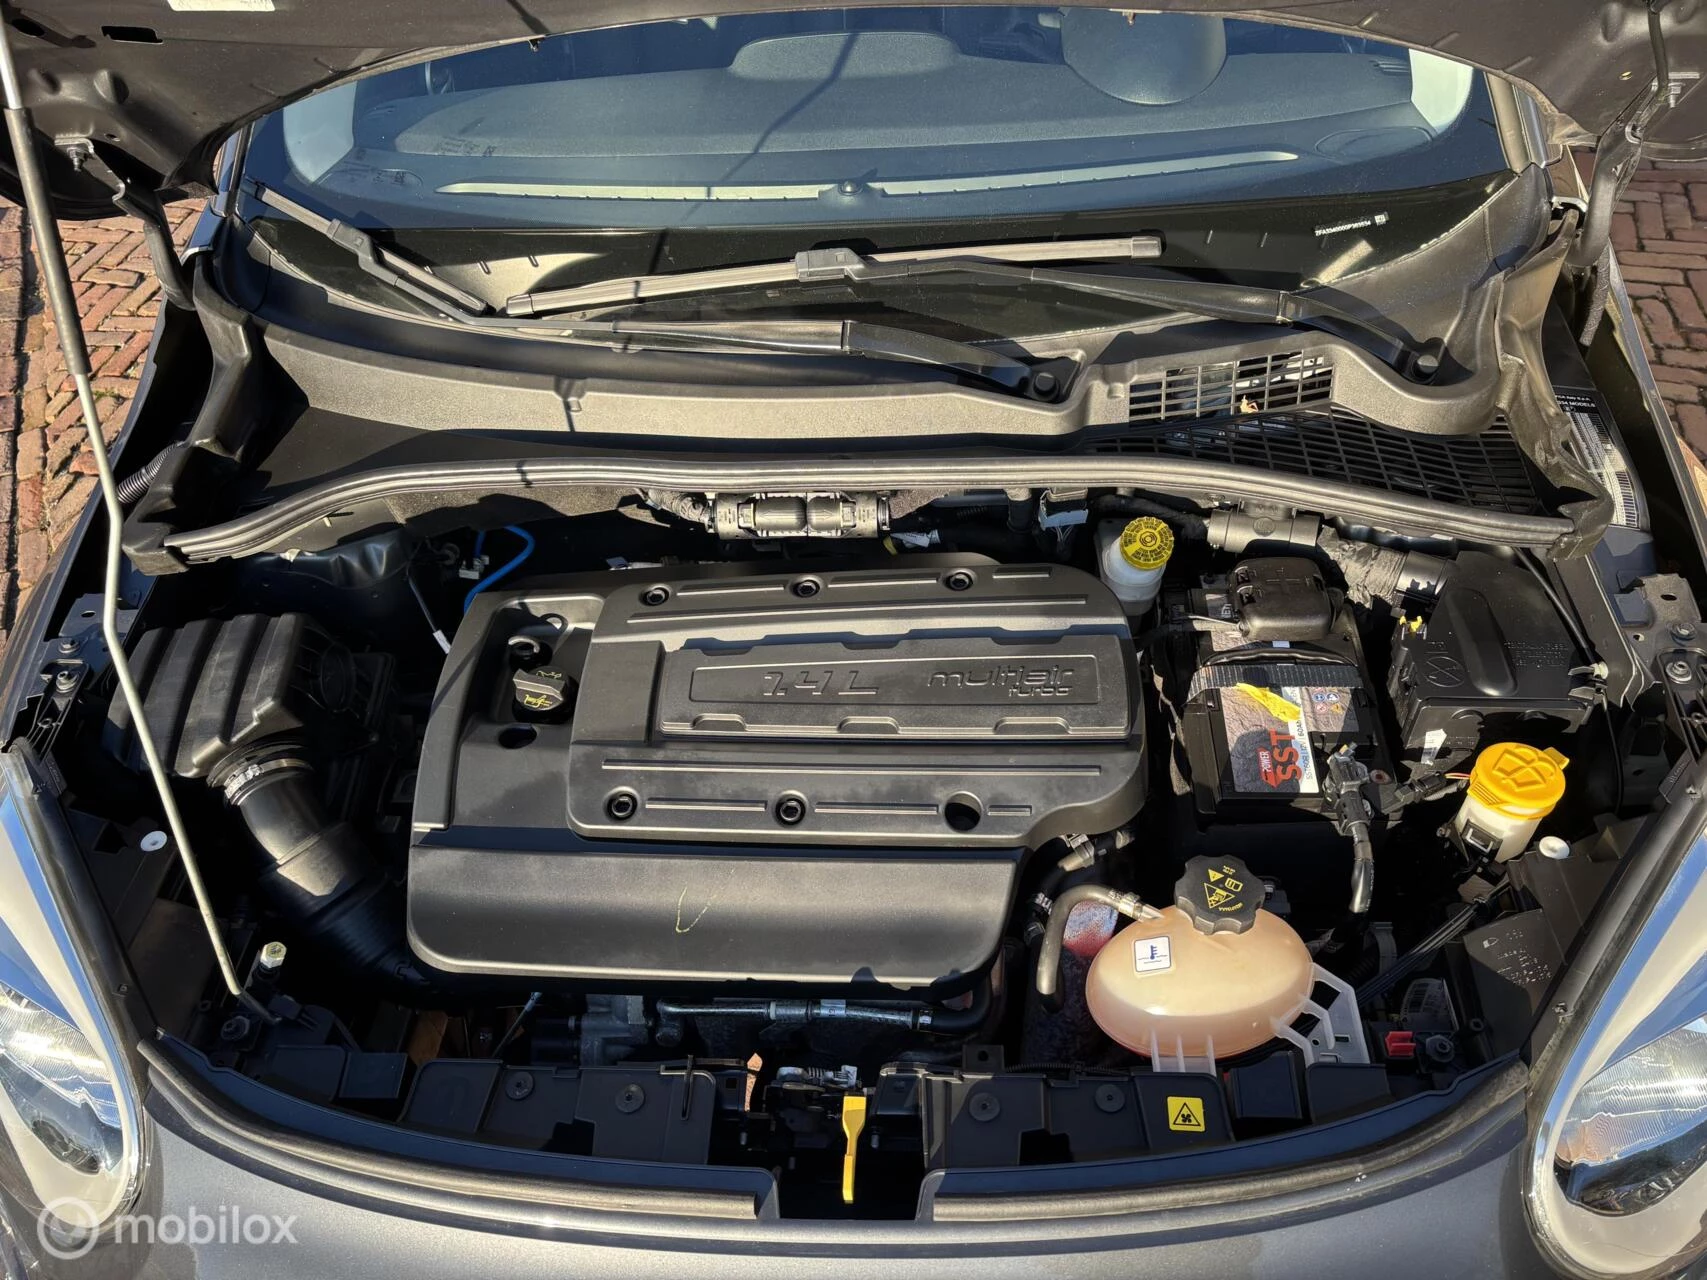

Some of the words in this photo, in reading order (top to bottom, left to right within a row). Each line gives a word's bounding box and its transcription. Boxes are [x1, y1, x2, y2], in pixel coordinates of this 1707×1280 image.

[927, 663, 1075, 687] multiair
[1008, 684, 1073, 697] turbo
[1259, 751, 1272, 773] POWER
[1269, 728, 1302, 780] SST
